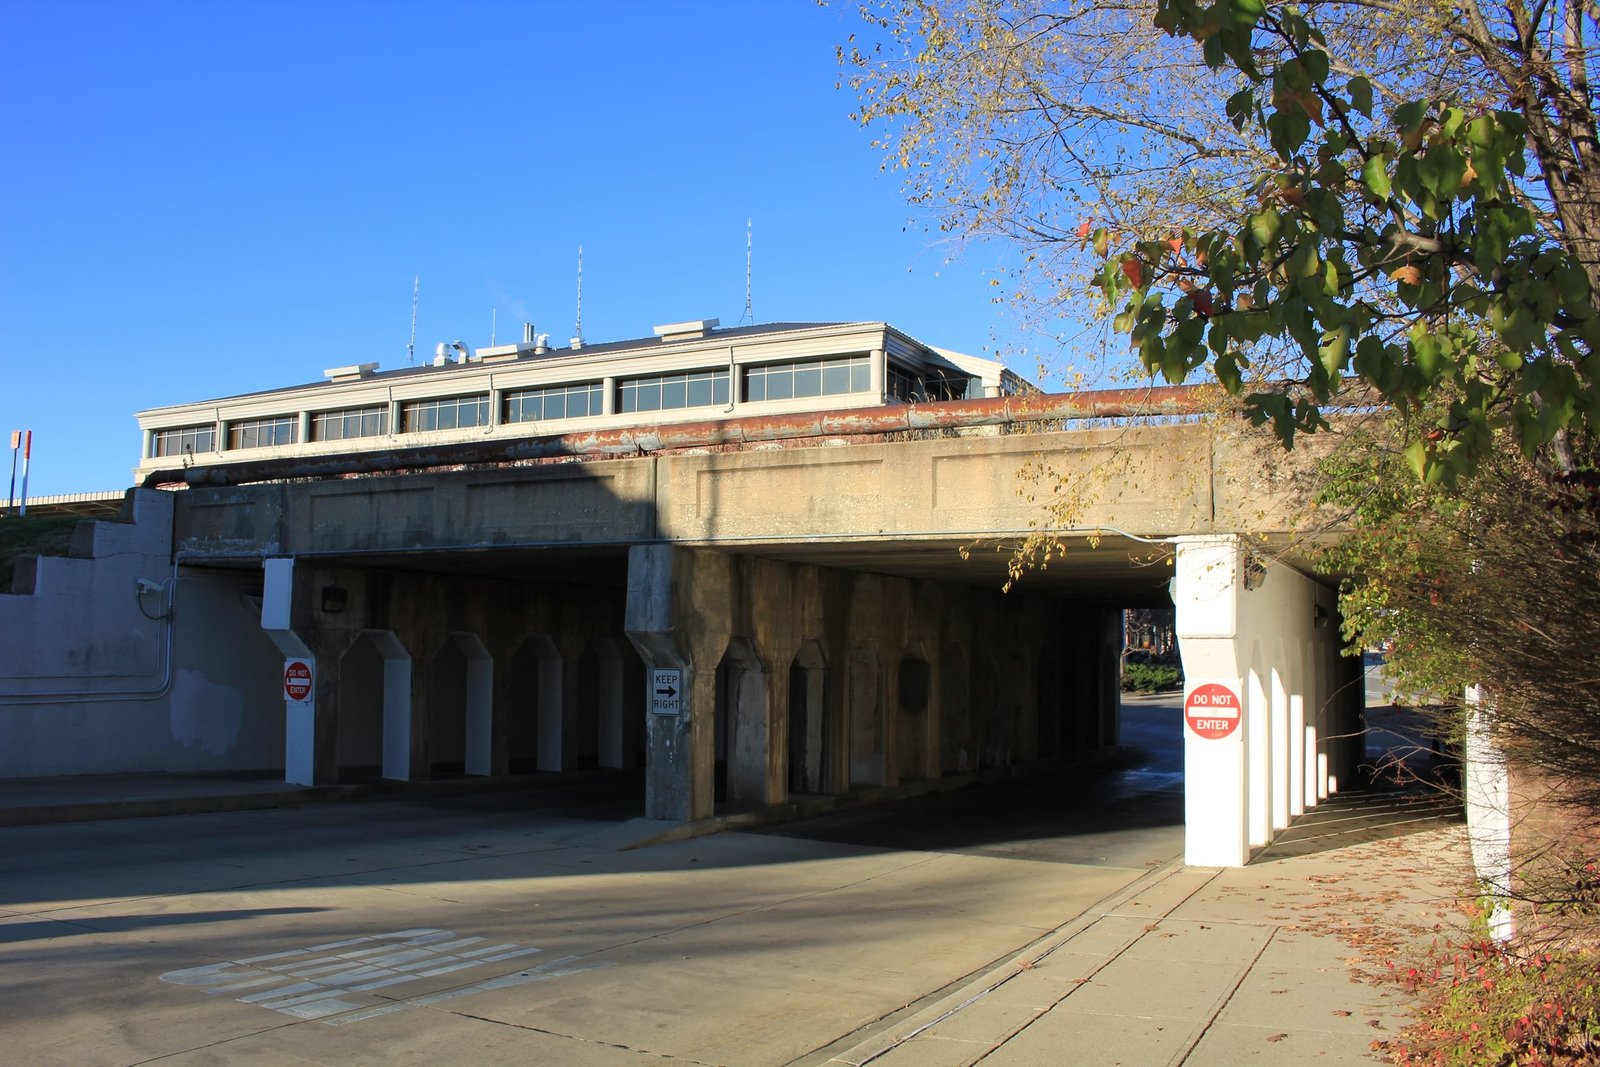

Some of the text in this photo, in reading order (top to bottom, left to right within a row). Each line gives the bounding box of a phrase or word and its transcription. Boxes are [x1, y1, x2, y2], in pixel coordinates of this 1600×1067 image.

[655, 674, 678, 684] KEEP
[653, 699, 679, 709] RIGHT
[1193, 694, 1232, 705] DO NOT
[1196, 719, 1229, 730] ENTER
[159, 928, 617, 1026] ONLY
